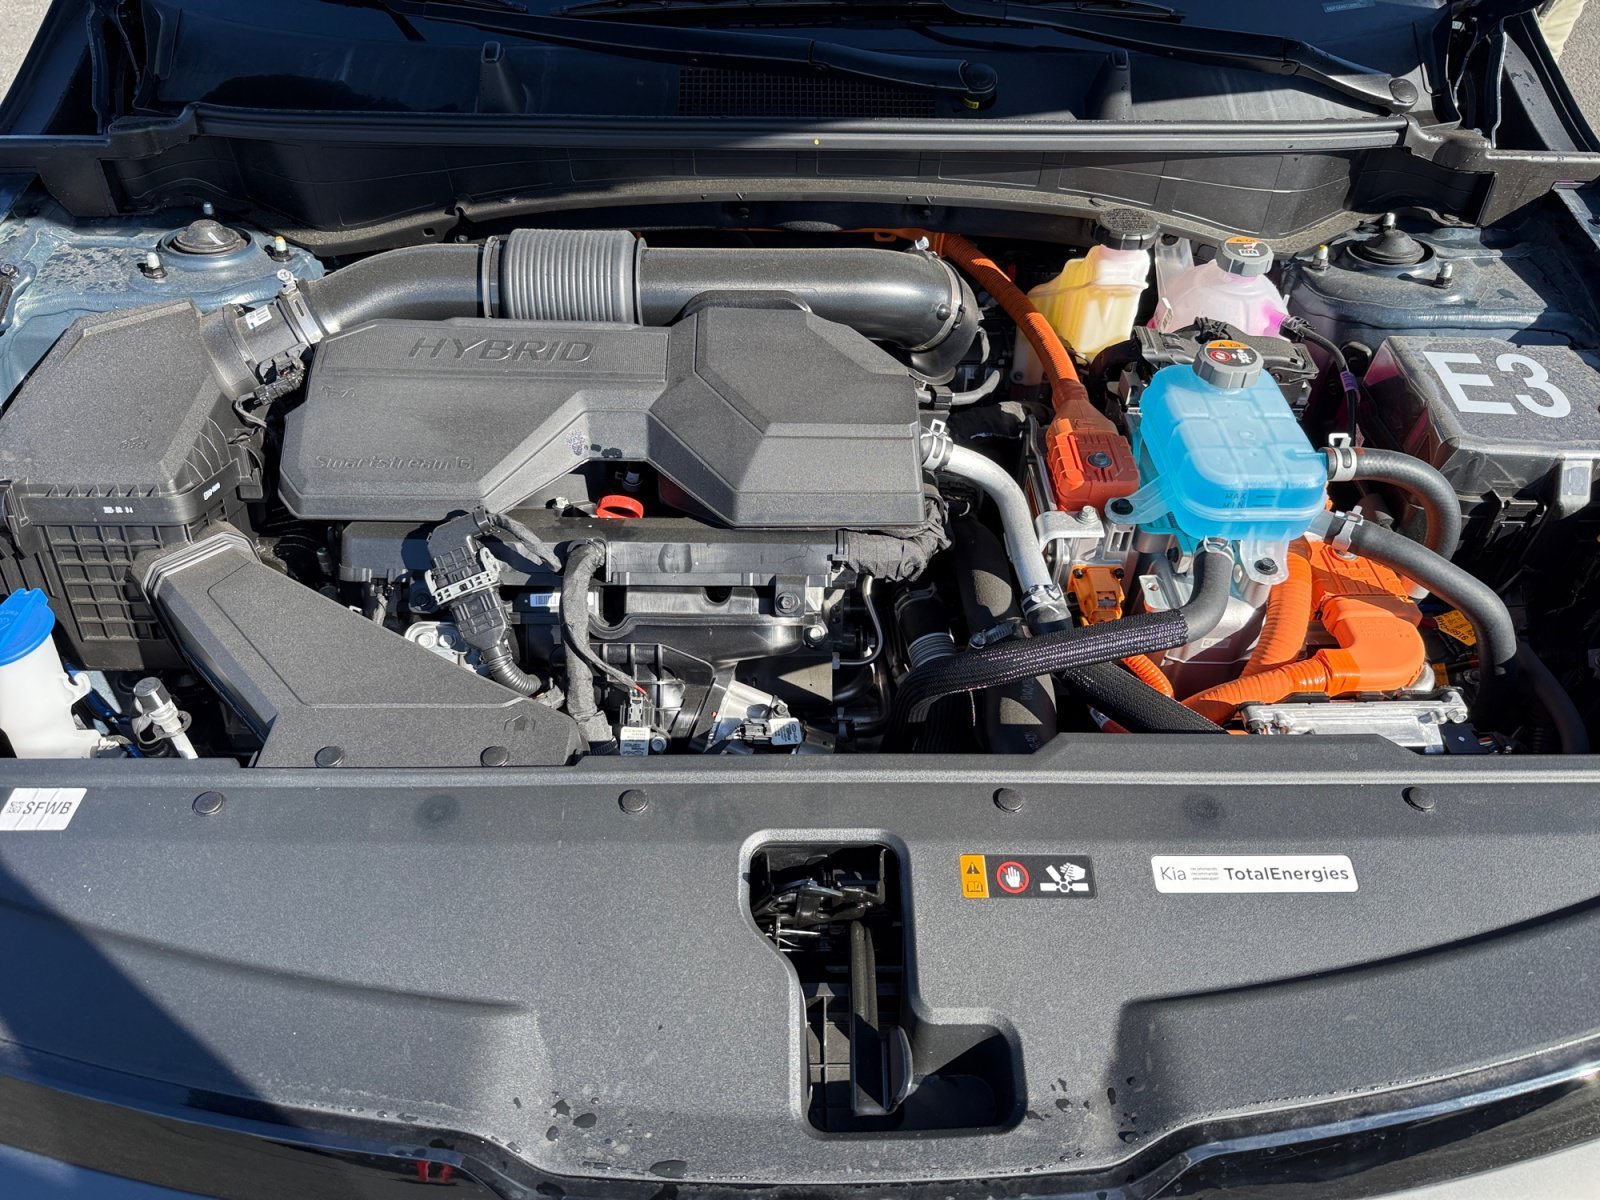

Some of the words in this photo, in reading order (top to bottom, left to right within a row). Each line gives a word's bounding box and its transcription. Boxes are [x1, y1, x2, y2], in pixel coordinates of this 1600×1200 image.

[408, 336, 594, 362] HYBRID
[1422, 351, 1571, 418] E3
[313, 455, 449, 471] Smartstream
[22, 801, 72, 815] SFWB
[1160, 866, 1187, 880] Kia
[1223, 866, 1349, 882] TotalEnergies
